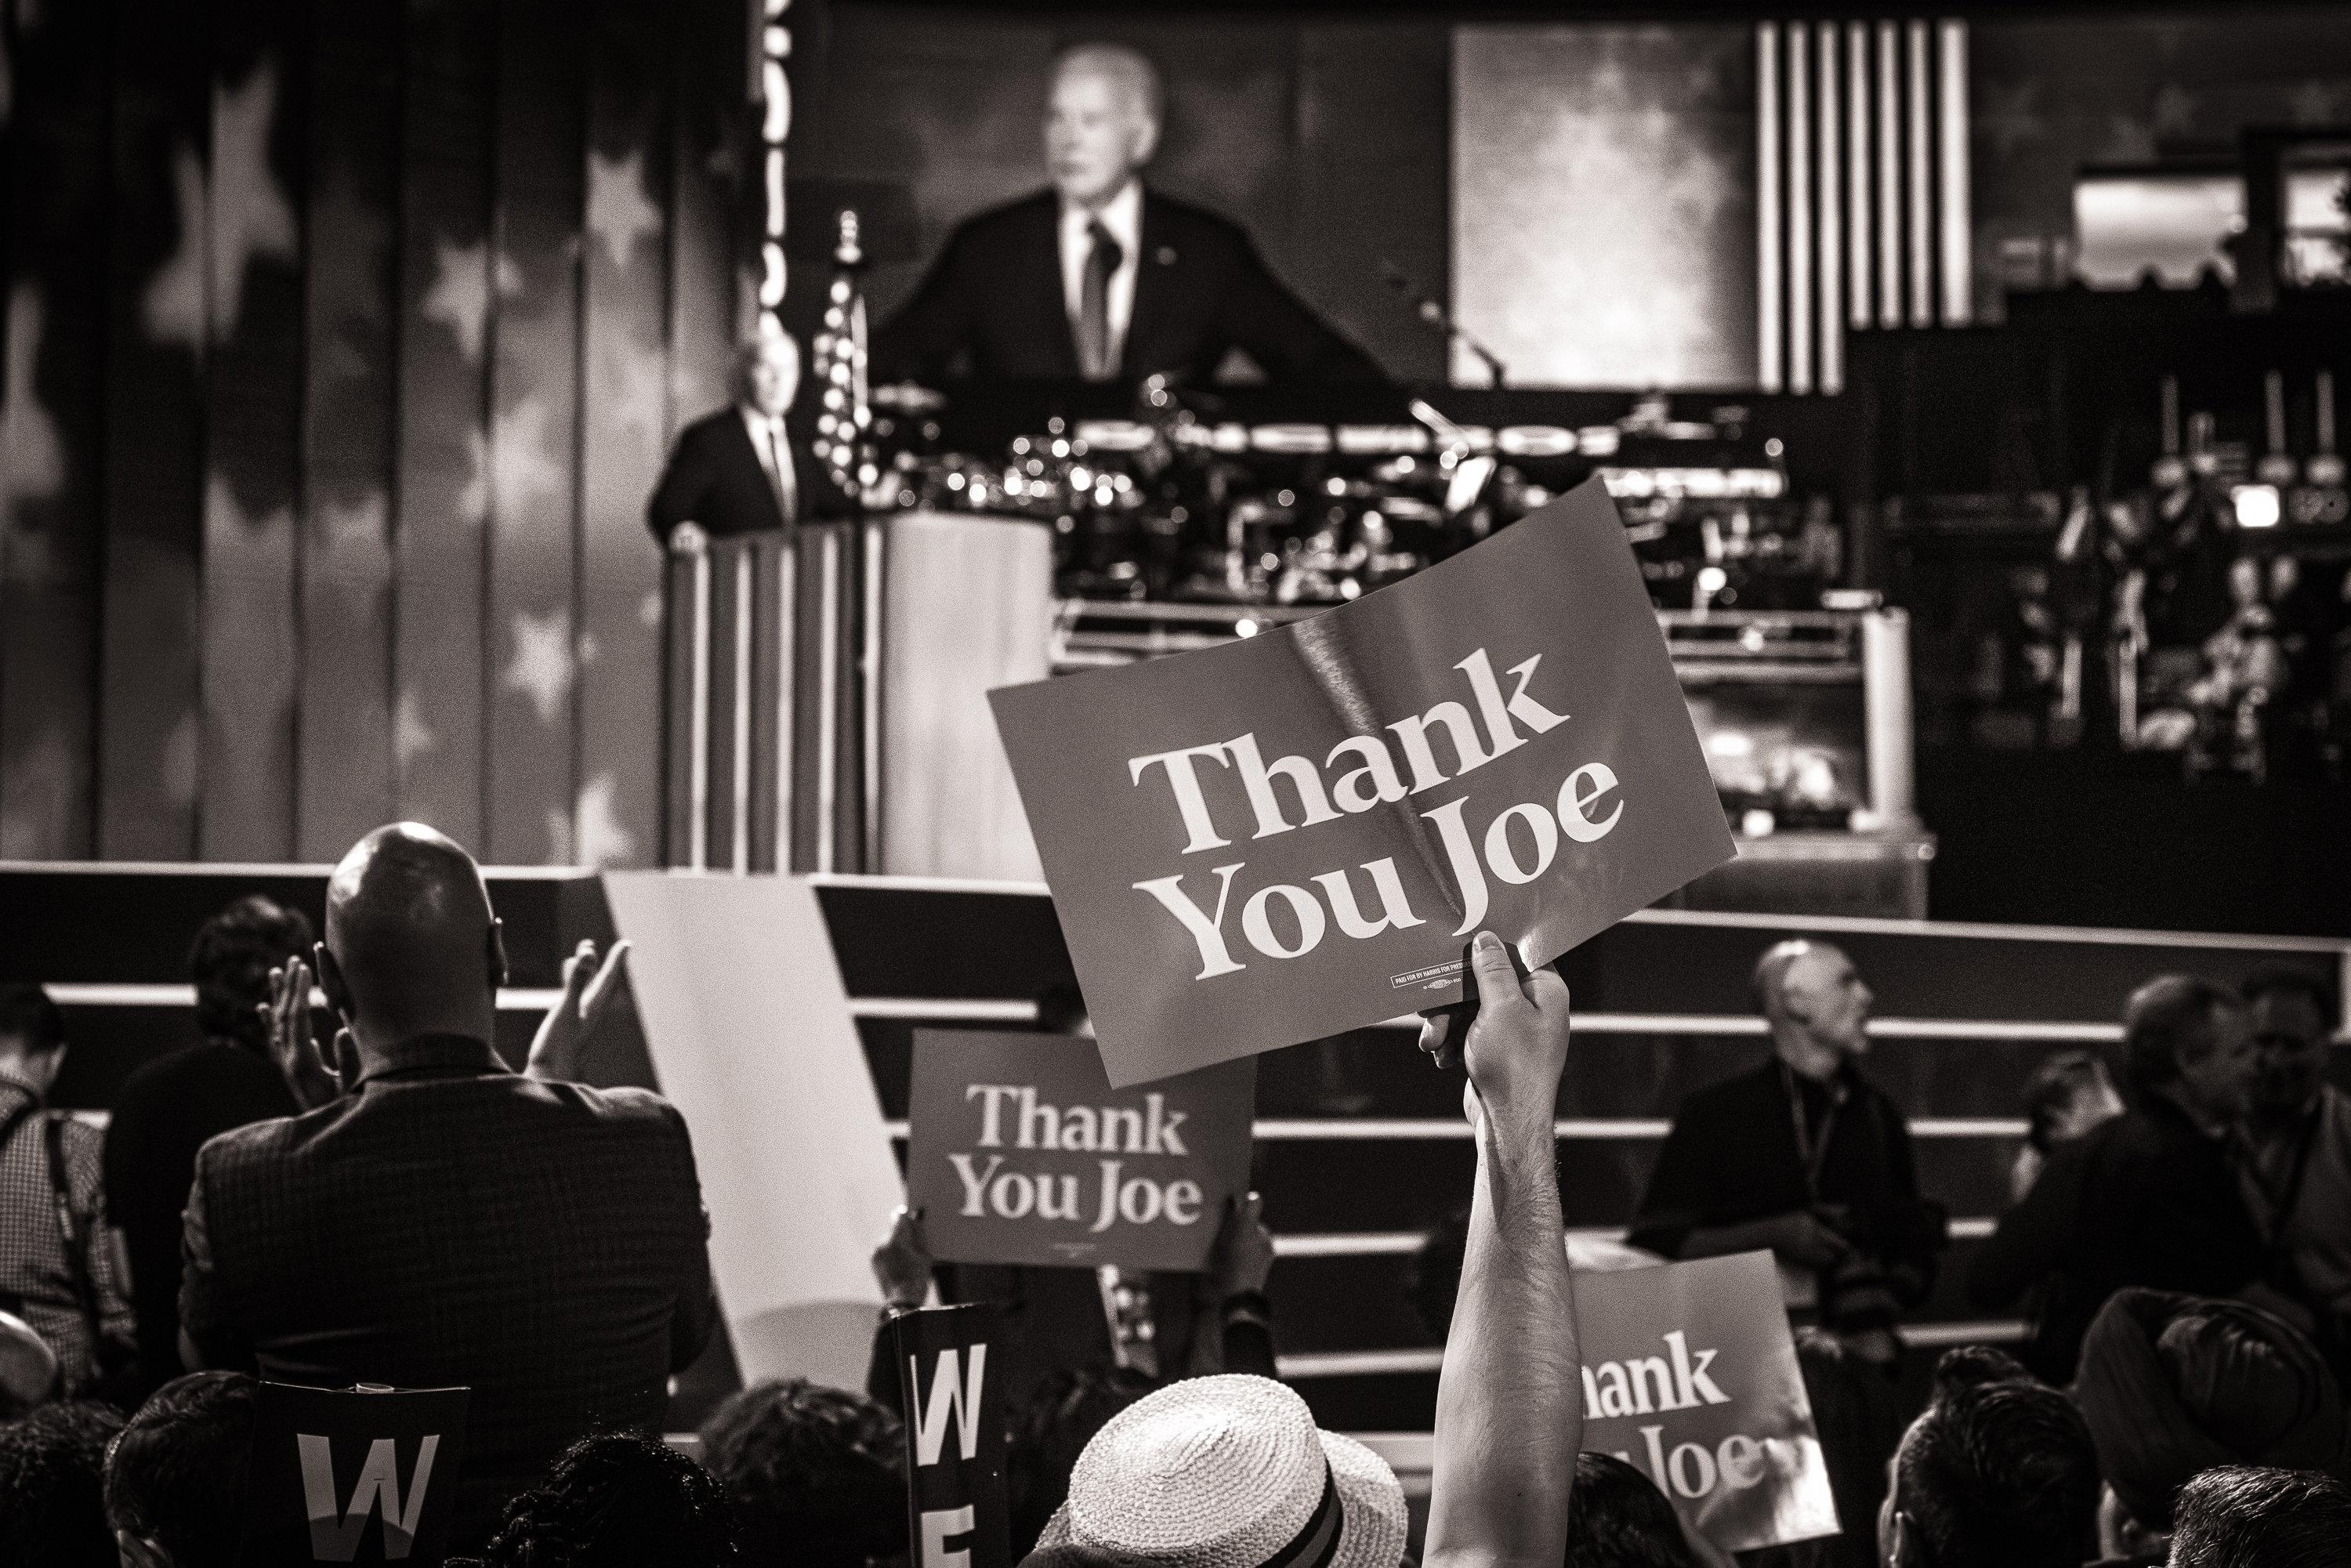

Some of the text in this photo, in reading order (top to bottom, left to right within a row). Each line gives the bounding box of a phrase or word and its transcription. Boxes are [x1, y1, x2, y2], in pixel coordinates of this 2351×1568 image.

[1128, 648, 1570, 854] Thank
[1132, 762, 1624, 981] You Joe
[1423, 968, 1441, 977] HARRIS
[965, 1084, 1187, 1155] Thank
[947, 1153, 1204, 1233] You Joe
[1581, 1330, 1732, 1420] ank
[295, 1432, 441, 1563] W
